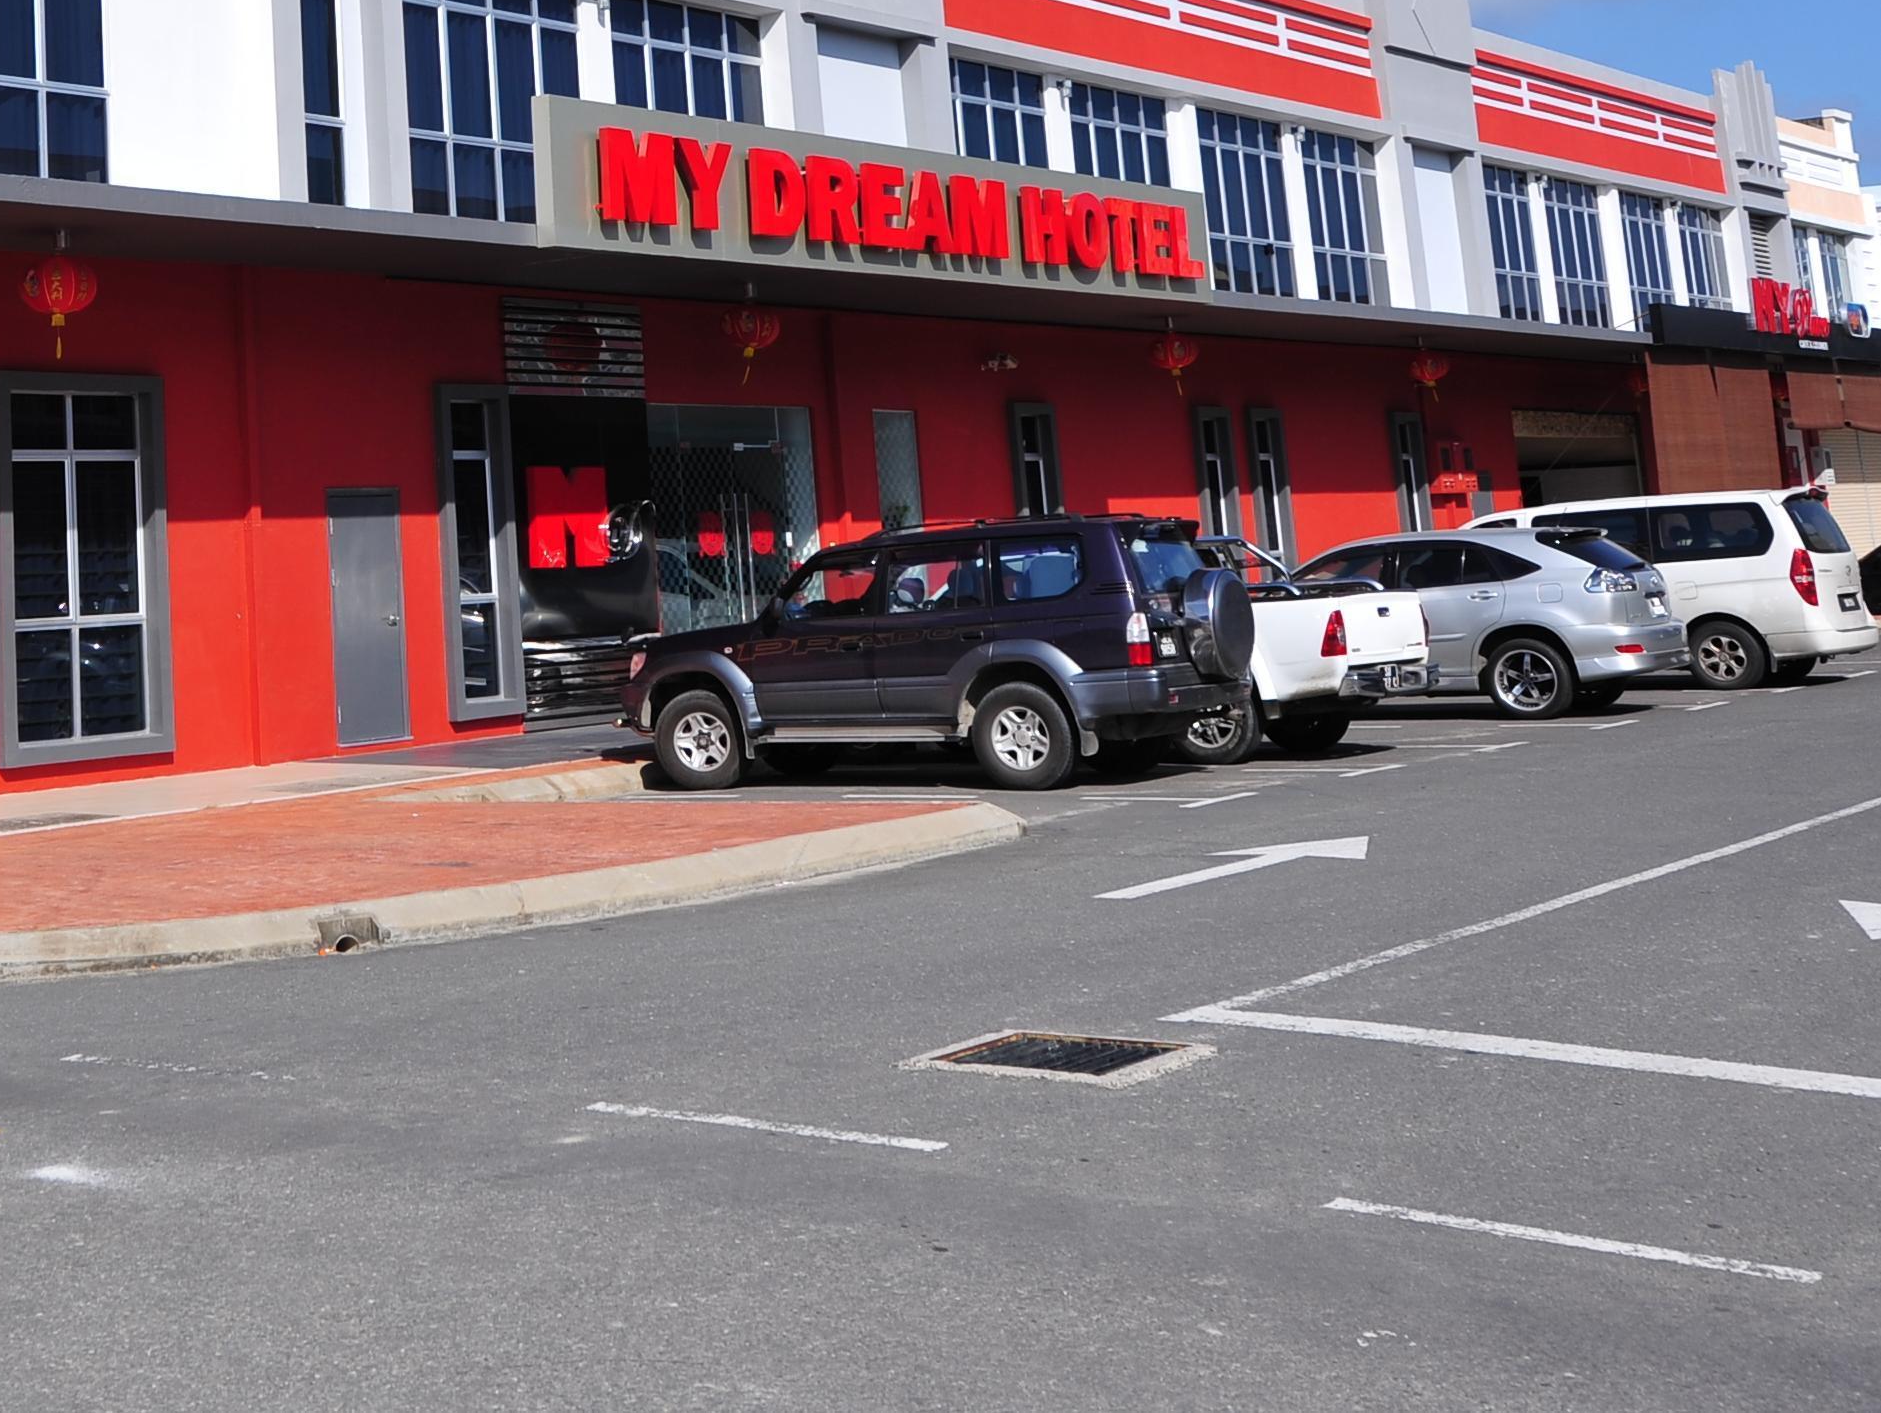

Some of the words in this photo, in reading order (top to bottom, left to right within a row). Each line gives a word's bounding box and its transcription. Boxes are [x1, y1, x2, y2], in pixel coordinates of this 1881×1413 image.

[598, 126, 731, 231] MY
[747, 147, 1010, 260] DREAM
[1019, 185, 1205, 279] HOTEL
[737, 627, 957, 662] PRADO
